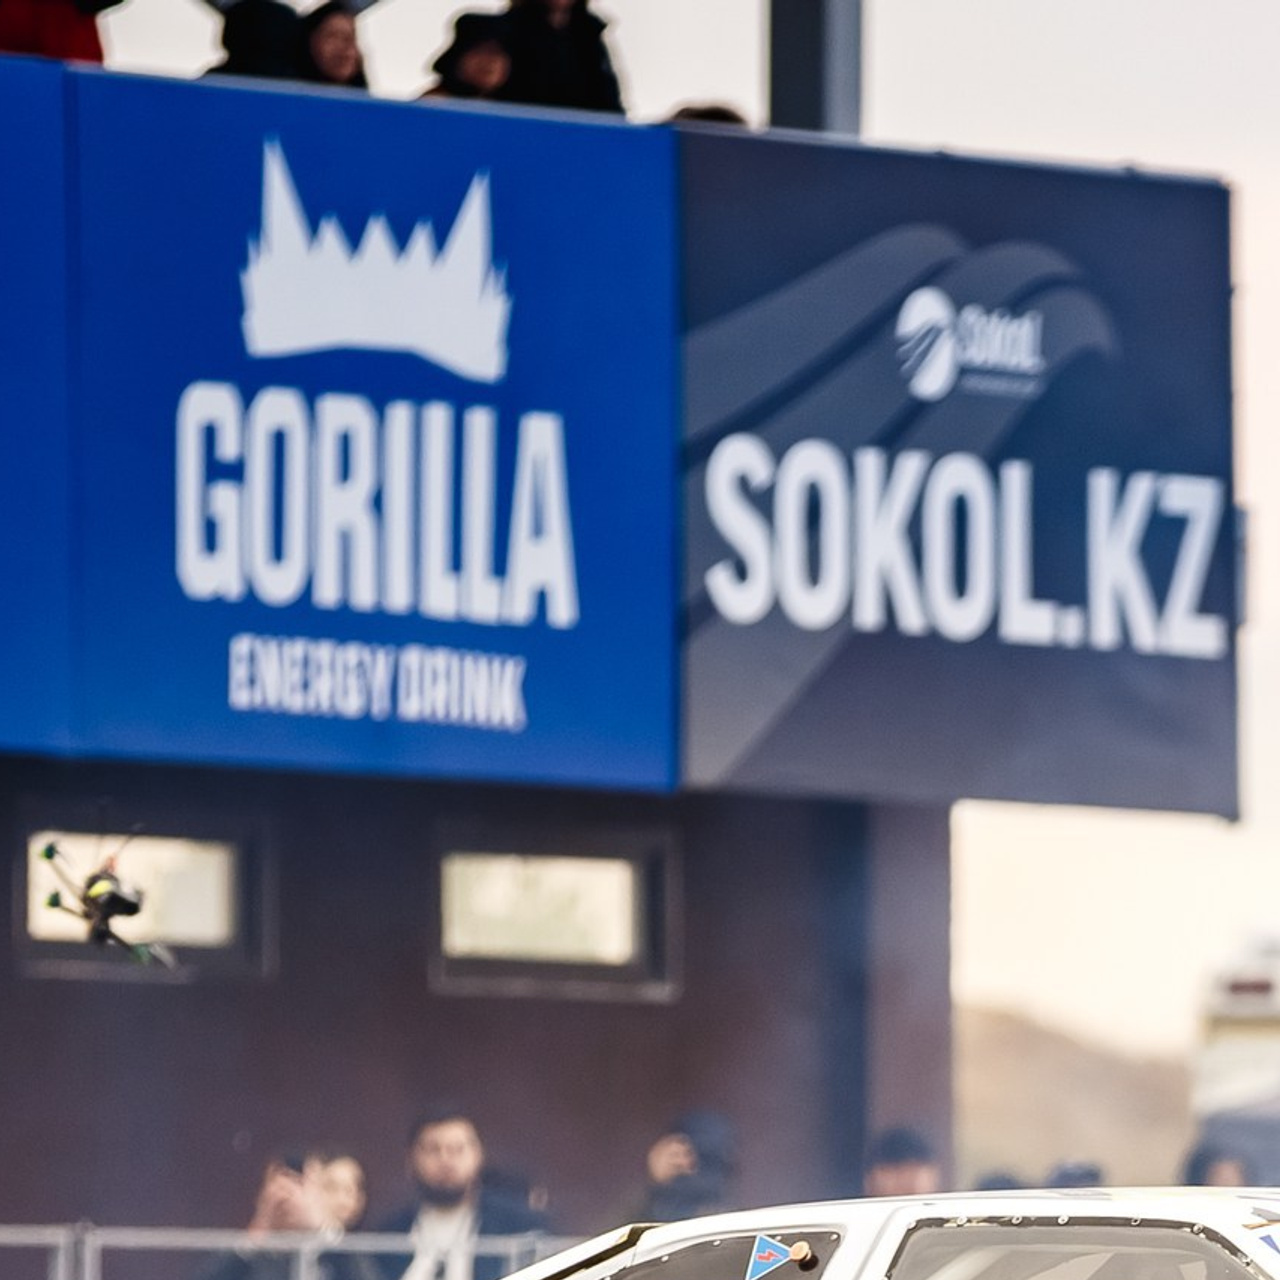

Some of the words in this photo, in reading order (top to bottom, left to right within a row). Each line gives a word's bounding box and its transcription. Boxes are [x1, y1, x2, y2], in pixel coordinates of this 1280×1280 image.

[175, 380, 581, 631] GORILLA
[704, 432, 1228, 658] SOKOL.KZ
[228, 632, 395, 722] ENERGY
[398, 643, 528, 733] DRINK
